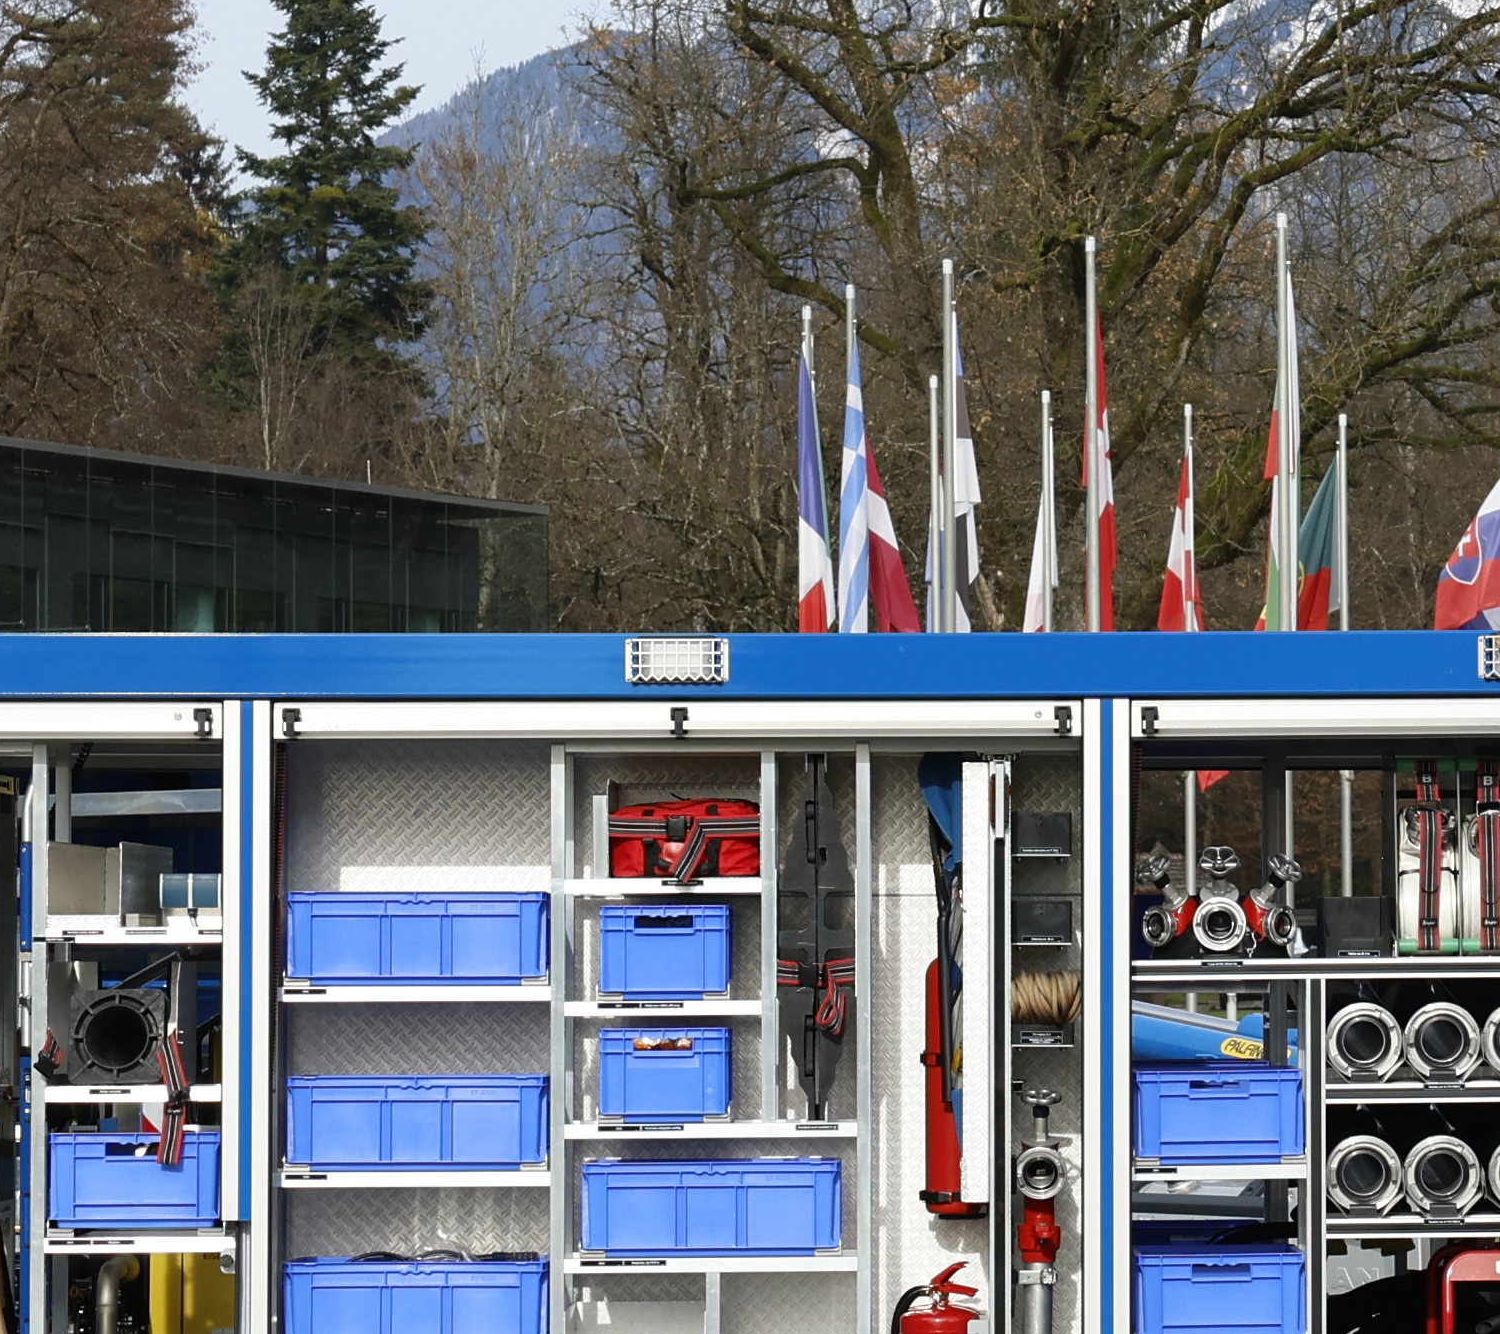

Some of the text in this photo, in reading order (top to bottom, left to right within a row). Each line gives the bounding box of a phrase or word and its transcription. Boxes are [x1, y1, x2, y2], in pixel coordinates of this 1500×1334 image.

[1422, 774, 1432, 783] B
[1483, 775, 1493, 785] B
[1224, 1039, 1264, 1058] PALFIN
